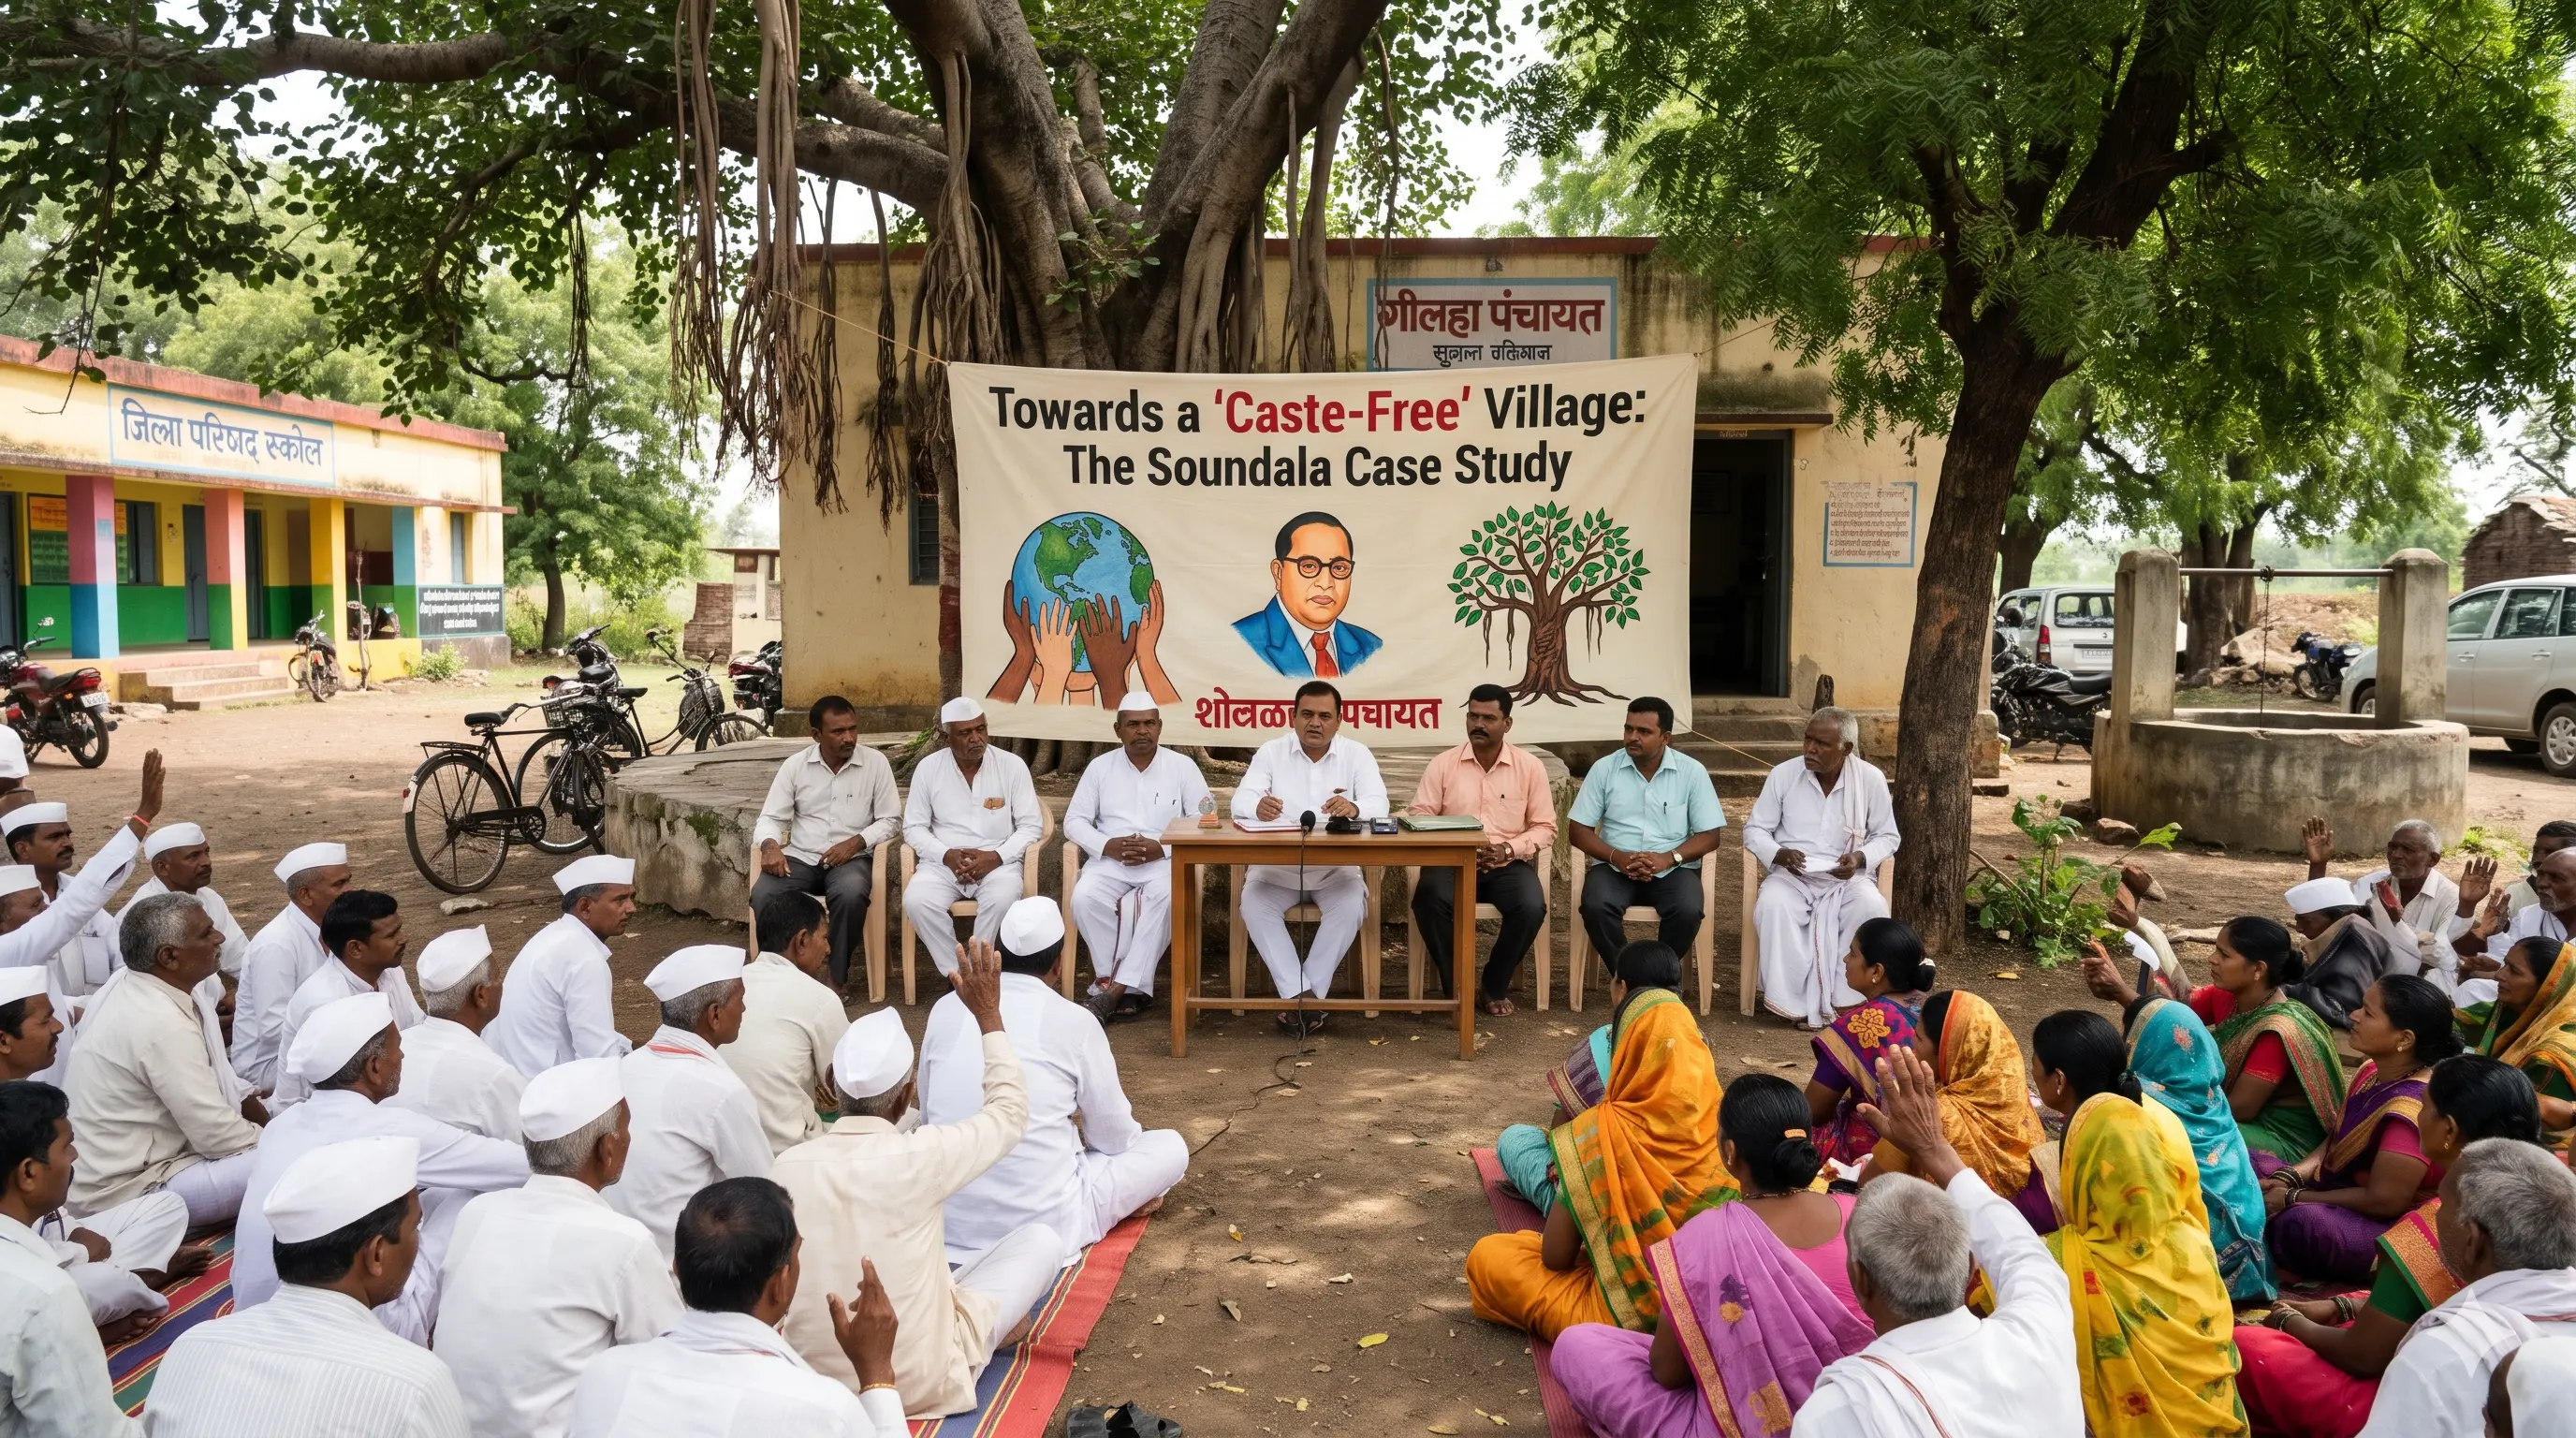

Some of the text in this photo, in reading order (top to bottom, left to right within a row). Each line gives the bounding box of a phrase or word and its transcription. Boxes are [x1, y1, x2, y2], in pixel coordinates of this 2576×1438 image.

[1488, 288, 1605, 336] पंचायत
[988, 387, 1164, 433] Towards
[1177, 402, 1201, 433] a
[1484, 384, 1647, 437] Village:
[1062, 440, 1573, 492] The Soundala Case Study
